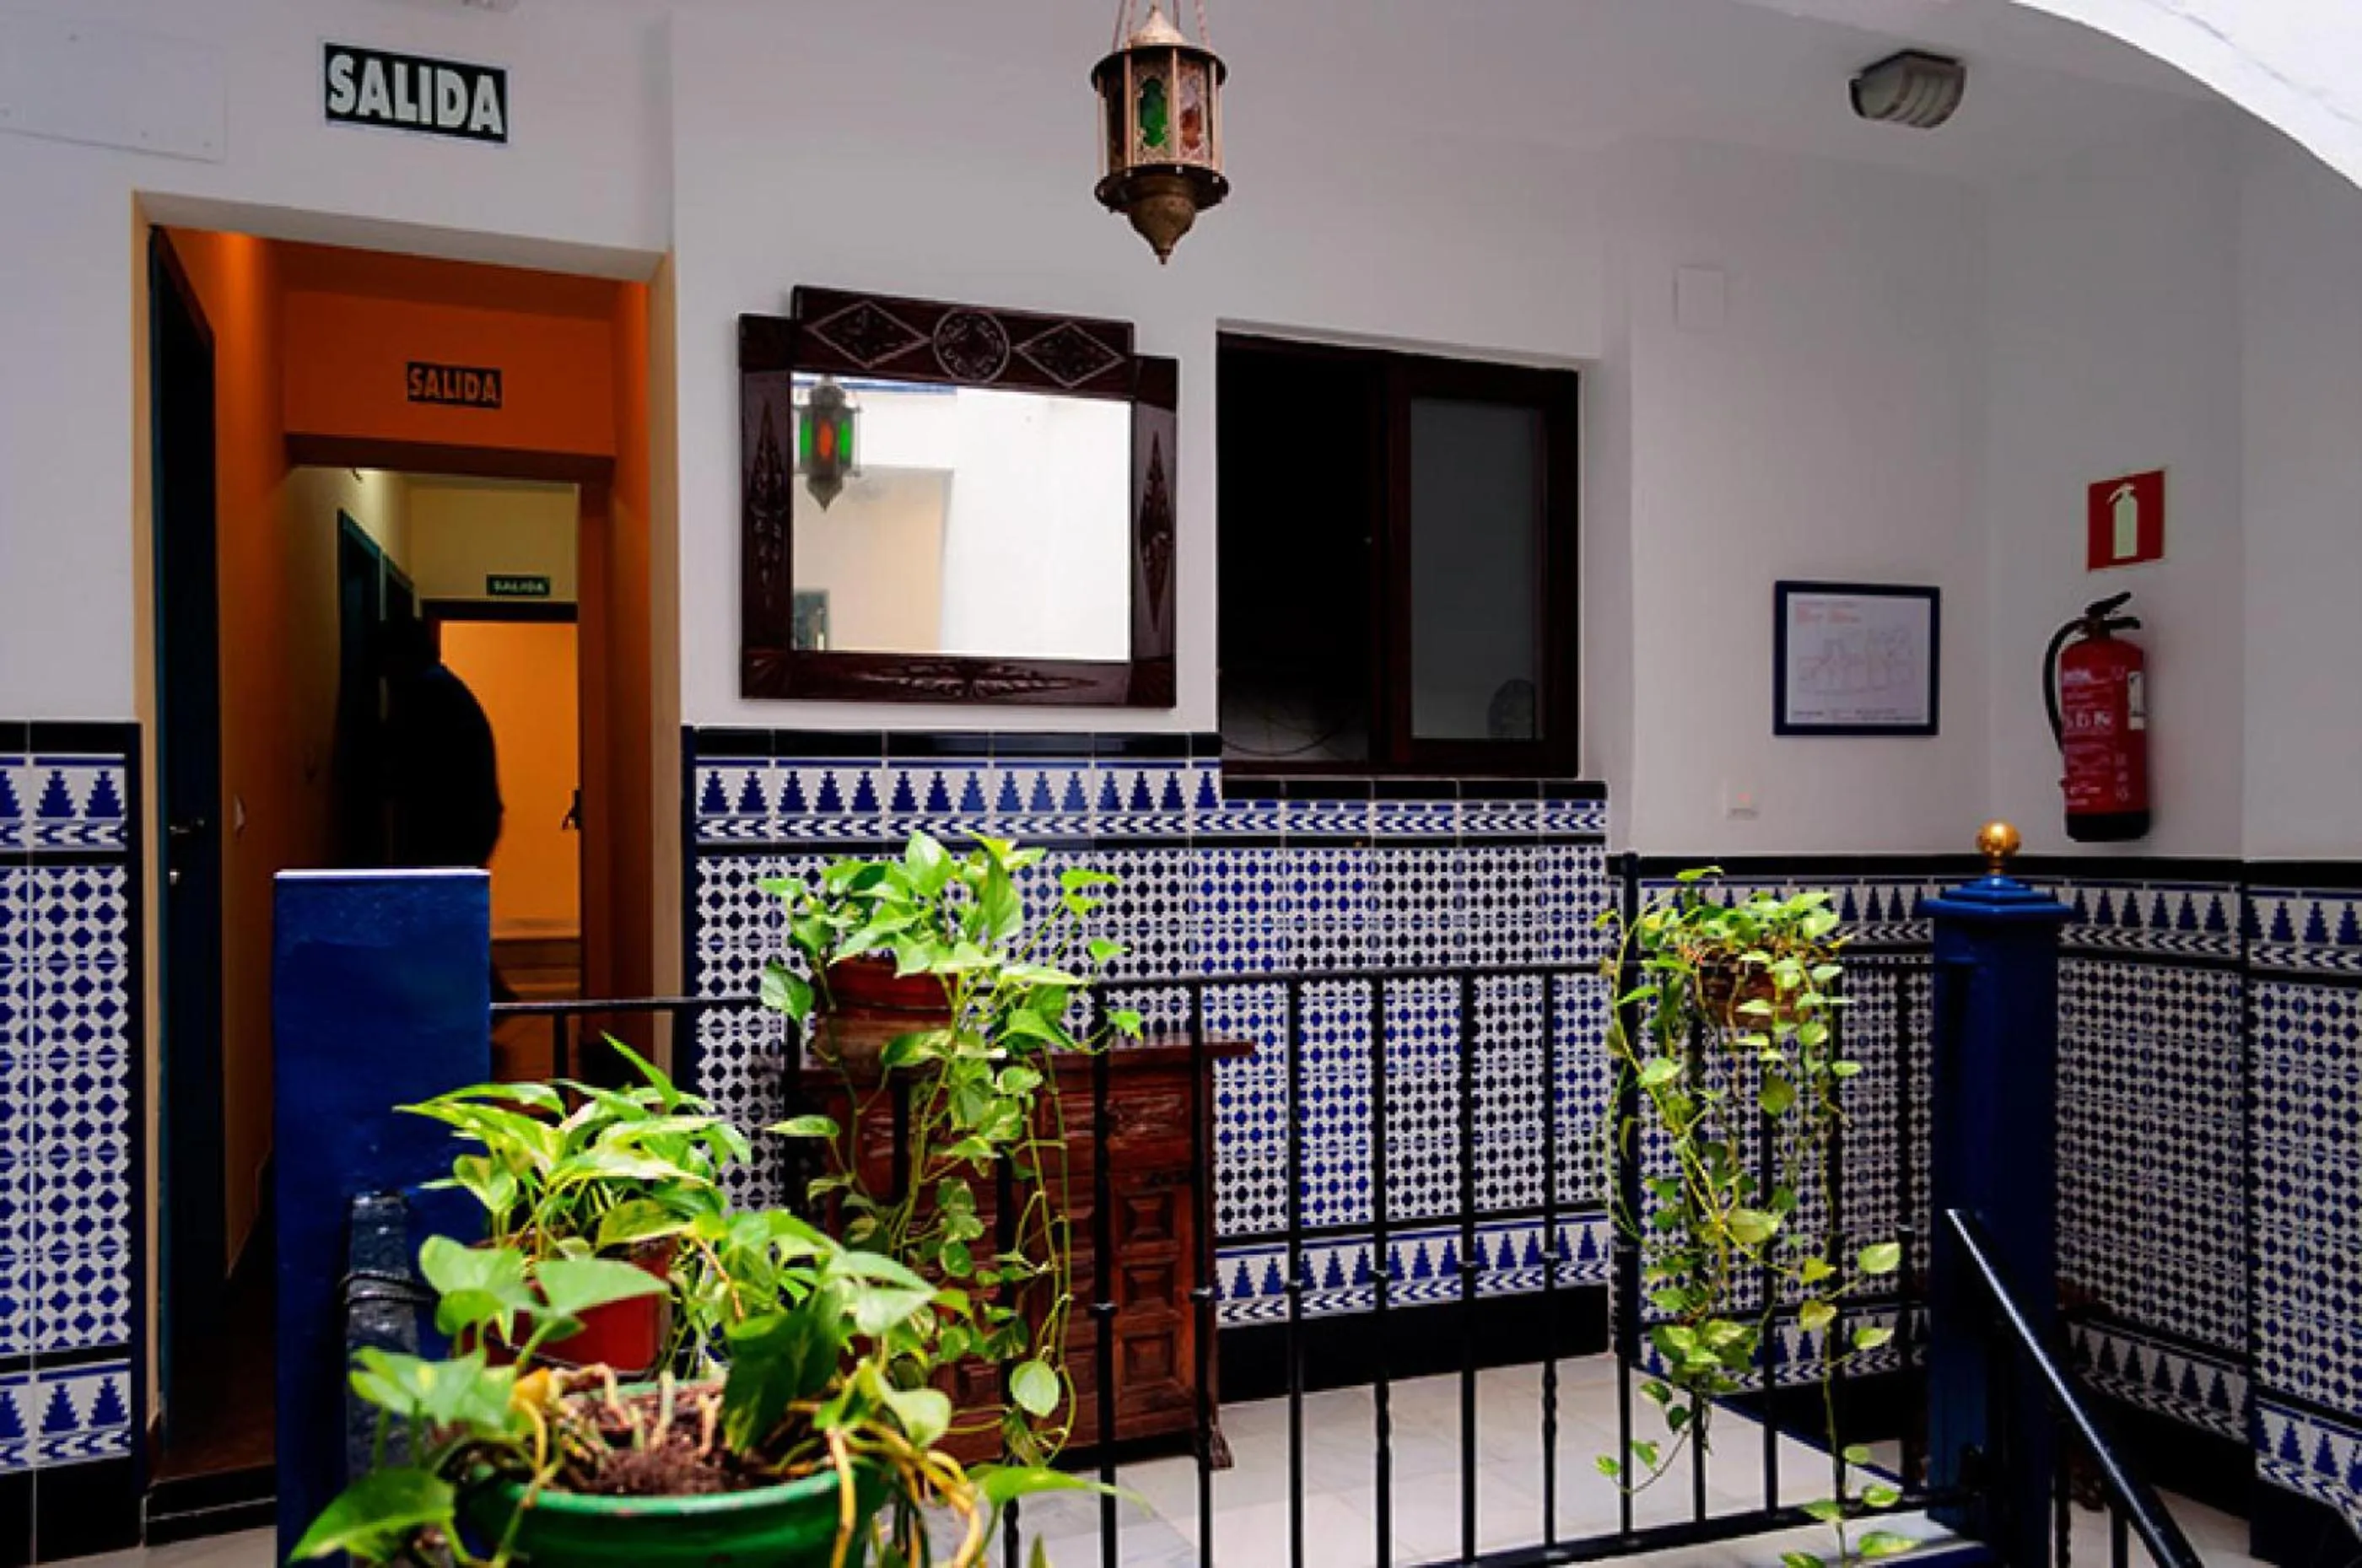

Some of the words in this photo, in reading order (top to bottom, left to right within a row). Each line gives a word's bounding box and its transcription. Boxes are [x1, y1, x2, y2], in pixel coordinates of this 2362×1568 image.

[327, 53, 504, 135] SALIDA
[409, 367, 499, 402] SALIDA
[493, 579, 546, 593] SALIDA
